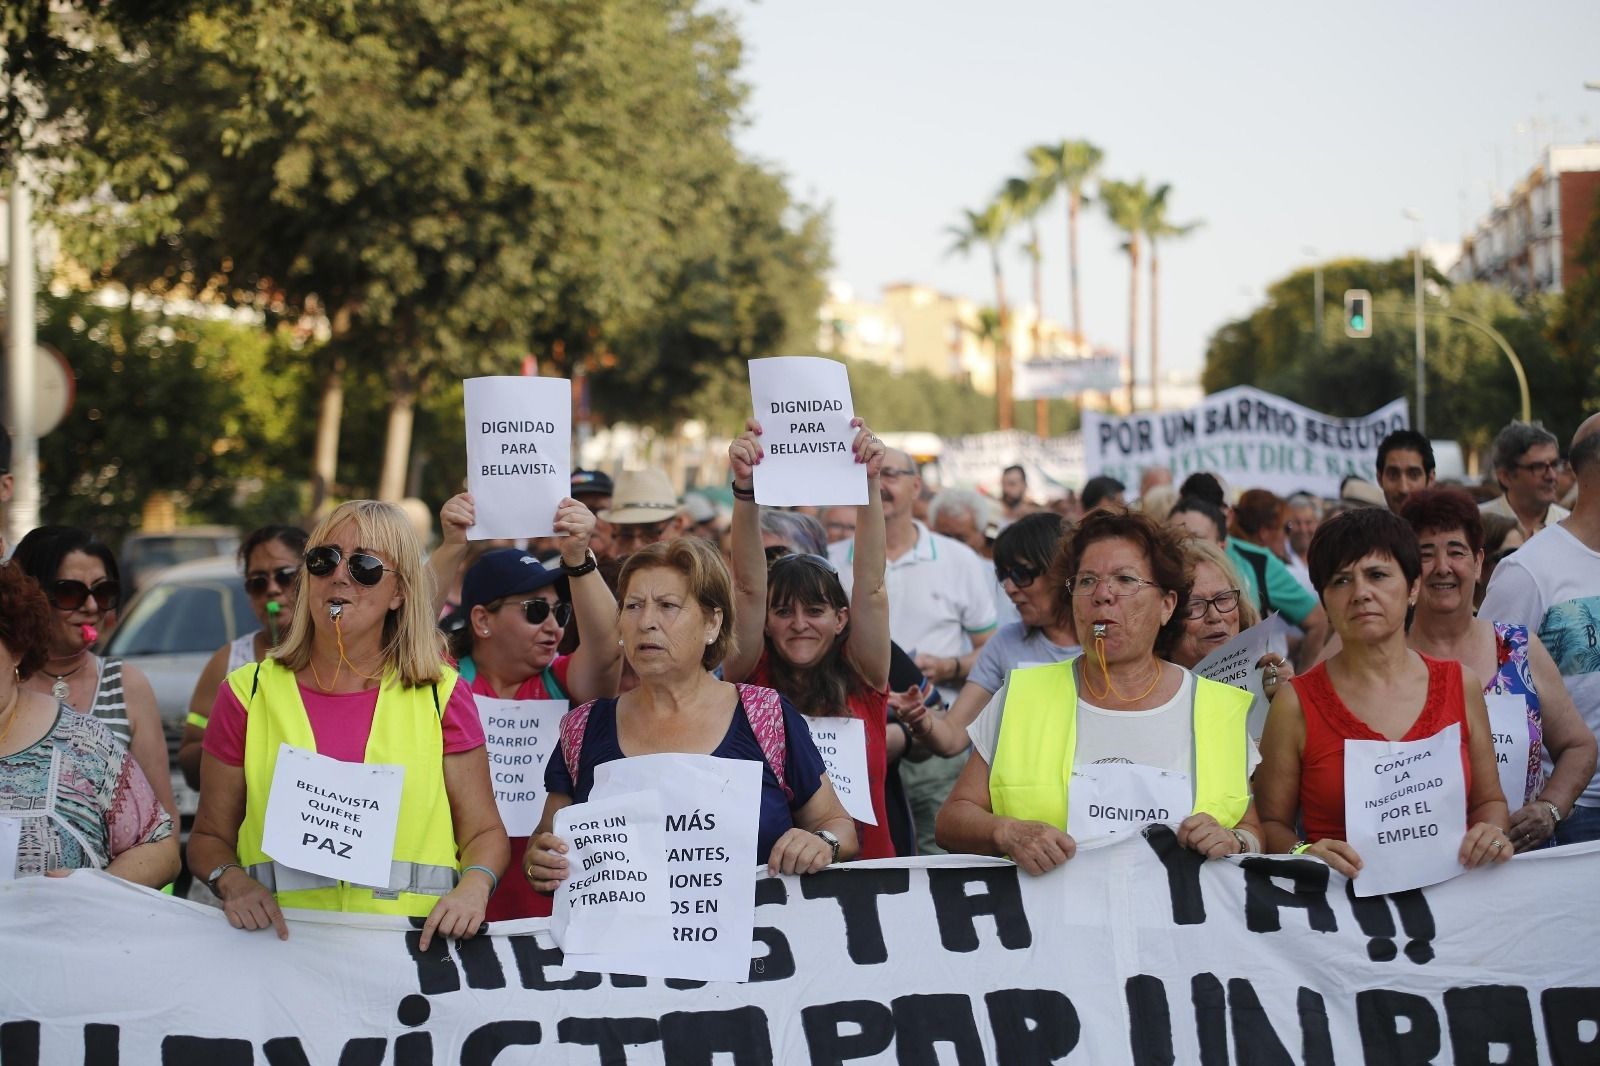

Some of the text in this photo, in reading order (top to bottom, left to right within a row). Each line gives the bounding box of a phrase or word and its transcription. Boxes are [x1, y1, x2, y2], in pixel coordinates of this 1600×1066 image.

[771, 400, 843, 414] DIGNIDAD
[481, 420, 555, 434] DIGNIDAD
[790, 422, 826, 434] PARA
[1098, 419, 1154, 456] POR
[1161, 409, 1197, 447] UN
[1305, 412, 1403, 450] SEGURO
[501, 442, 537, 455] PARA
[770, 441, 847, 455] BELLAVISTA
[481, 463, 557, 476] BELLAVISTA
[487, 716, 540, 729] POR UN
[487, 734, 538, 748] BARRIO
[818, 732, 836, 741] UN
[1491, 733, 1514, 745] STA
[486, 751, 545, 766] EGURO Y
[1374, 751, 1432, 775] CONTRA
[495, 772, 524, 784] CON
[1394, 771, 1410, 784] LA
[296, 779, 380, 811] BELLAVISTA
[1364, 777, 1443, 808] INSEGURIDAD
[308, 799, 362, 823] QUIERE
[1381, 801, 1432, 822] POR EL
[301, 811, 363, 839] VIVIR EN
[569, 815, 627, 832] POR UN
[665, 808, 716, 832] MÁS
[573, 833, 628, 850] BARRIO
[1377, 823, 1439, 845] EMPLEO
[302, 832, 353, 860] PAZ
[665, 846, 730, 863] ANTES,
[582, 850, 630, 871] DIGNO,
[568, 869, 648, 893] SEGURIDAD
[569, 890, 646, 908] Y TRABAJO
[695, 899, 718, 914] EN
